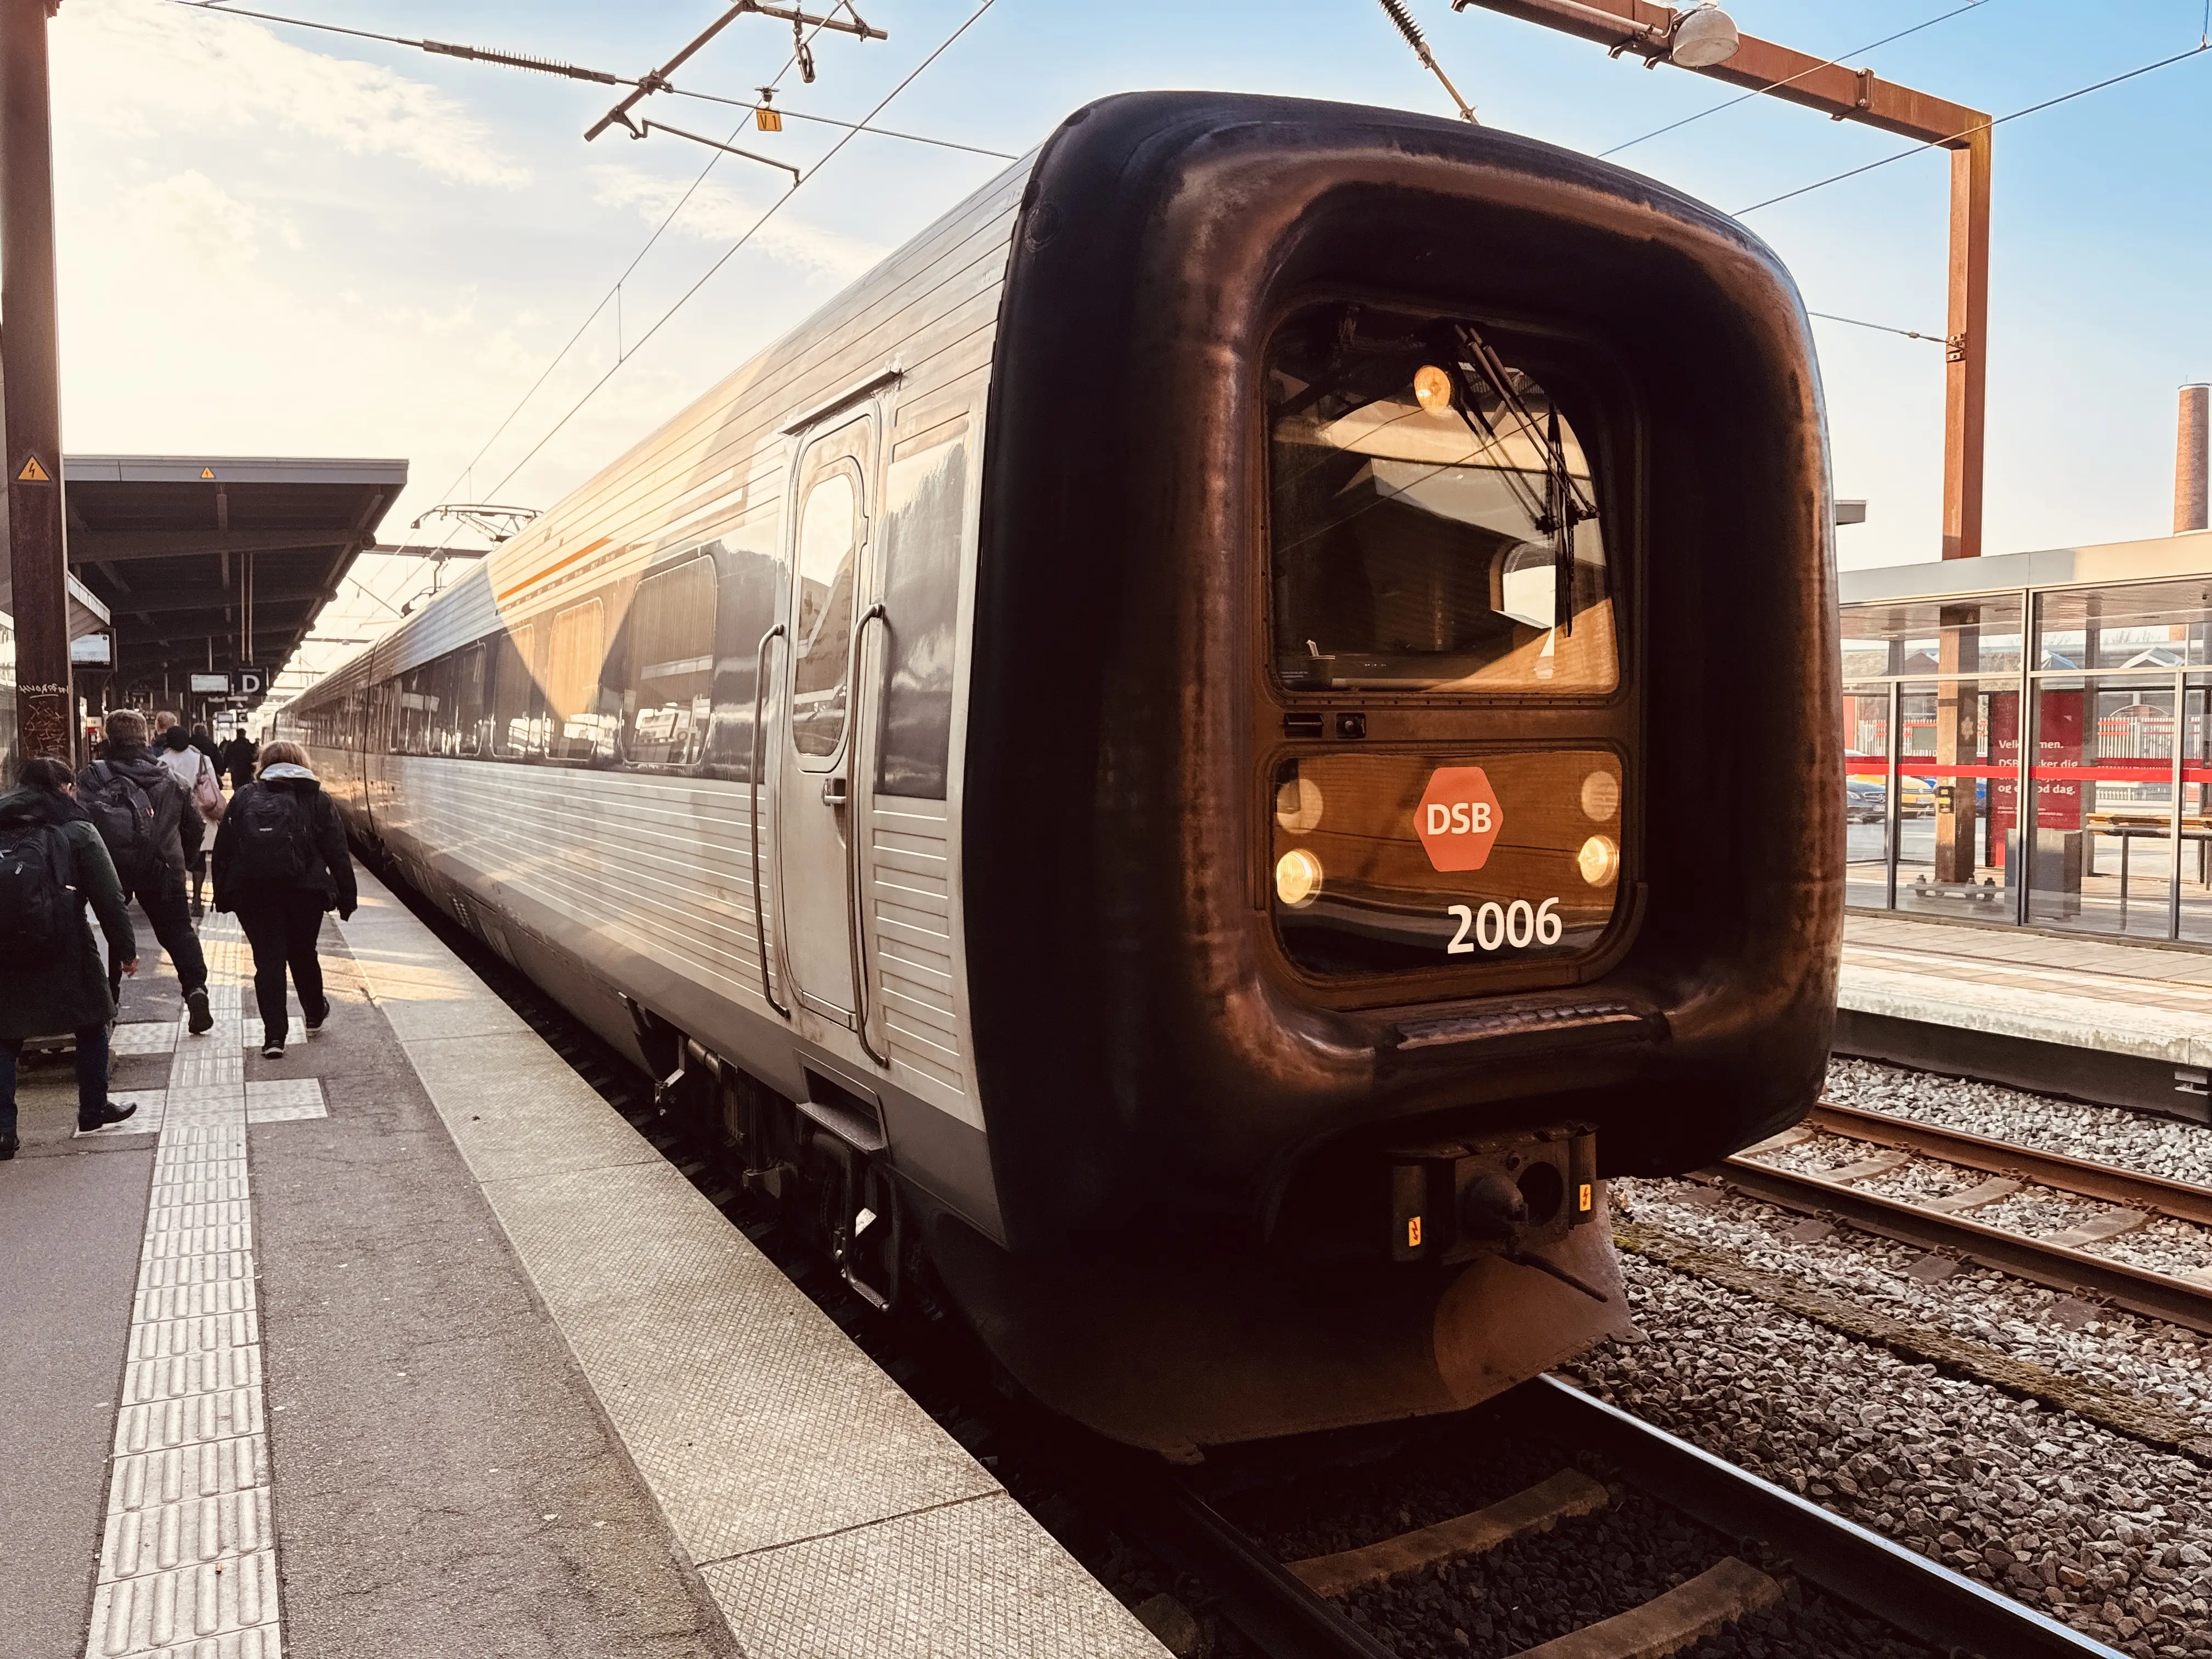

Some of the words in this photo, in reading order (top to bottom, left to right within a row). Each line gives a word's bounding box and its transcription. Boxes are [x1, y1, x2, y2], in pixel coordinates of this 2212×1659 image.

[242, 674, 260, 693] D
[1998, 740, 2064, 749] Velkmen.
[1997, 785, 2012, 794] og
[2037, 784, 2050, 793] od
[2052, 784, 2076, 795] dag.
[1427, 802, 1492, 835] DSB
[1447, 897, 1562, 954] 2006
